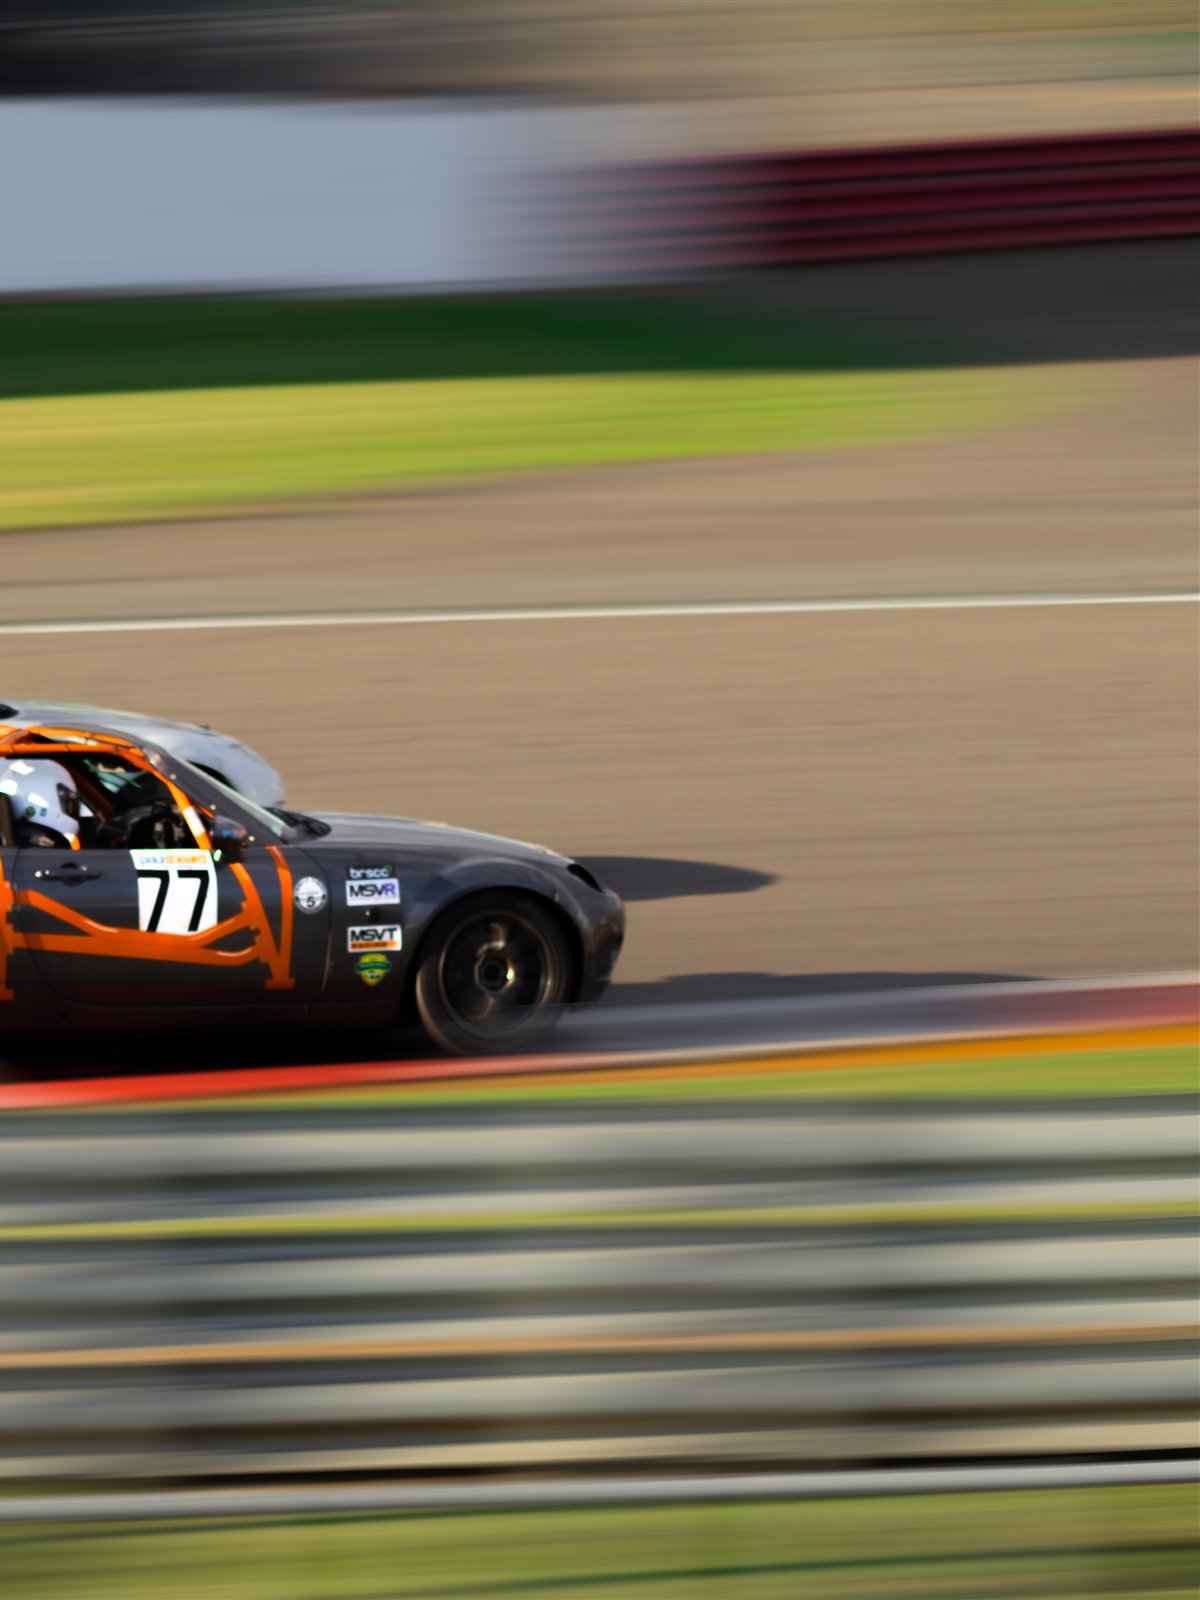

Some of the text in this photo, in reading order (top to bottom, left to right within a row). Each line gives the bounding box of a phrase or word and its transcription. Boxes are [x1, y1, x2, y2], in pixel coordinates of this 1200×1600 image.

[349, 884, 397, 898] MSVR
[136, 869, 210, 933] 77
[350, 927, 398, 941] MSVT
